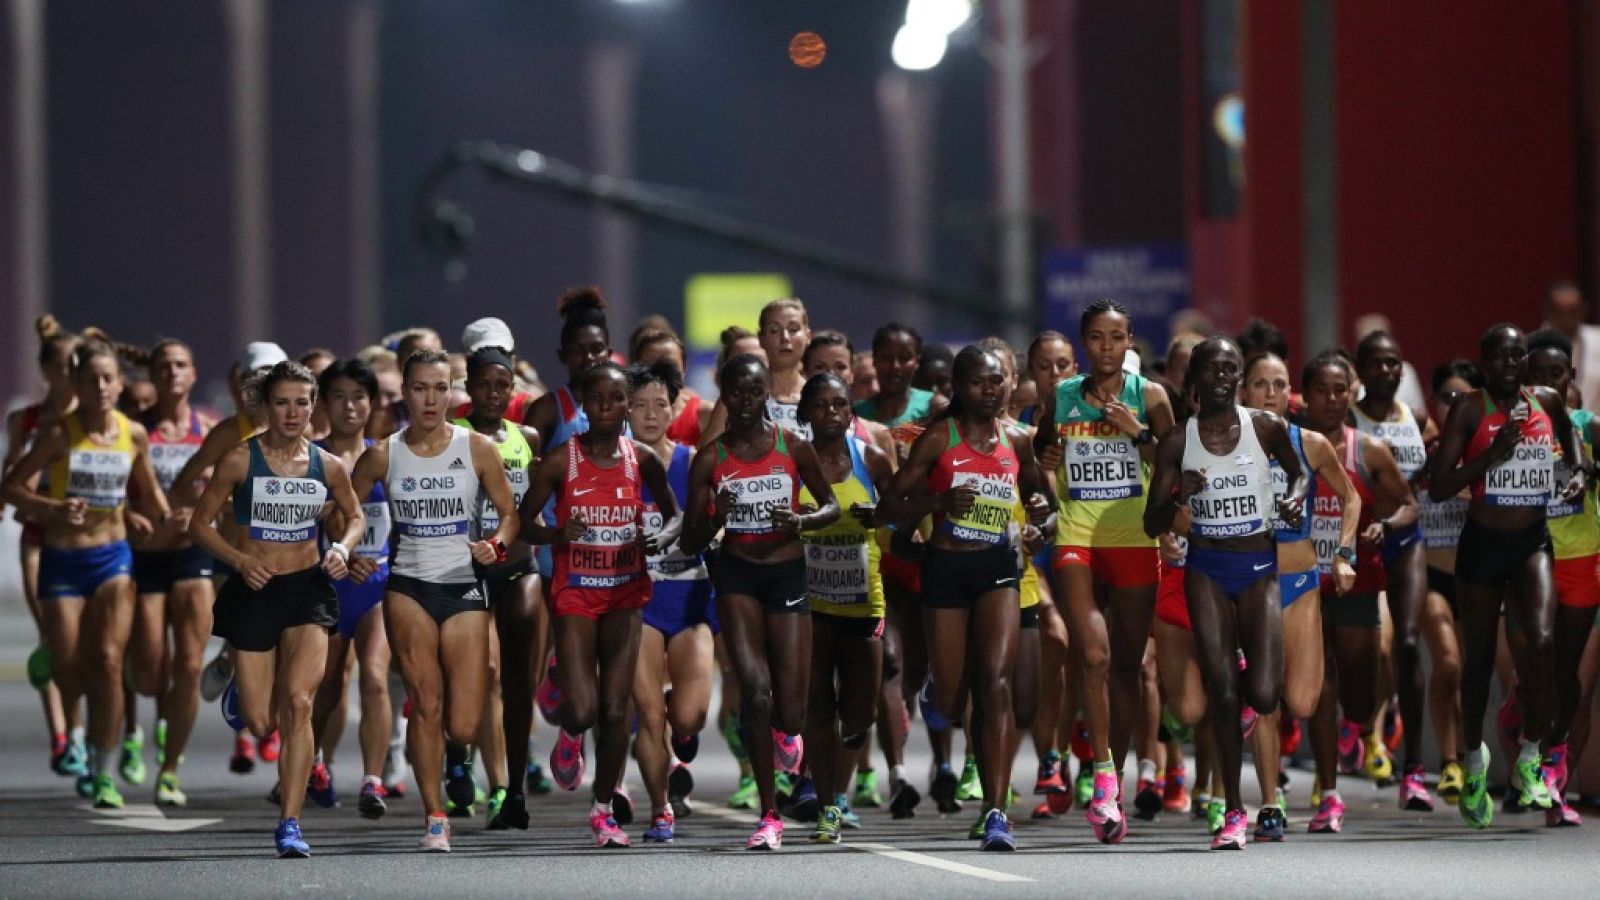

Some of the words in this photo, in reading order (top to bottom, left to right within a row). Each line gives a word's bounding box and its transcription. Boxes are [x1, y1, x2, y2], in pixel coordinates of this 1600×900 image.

[1093, 441, 1128, 454] QNB
[1517, 448, 1546, 460] QNB
[507, 472, 522, 483] NB
[1070, 461, 1137, 481] DEREJE
[420, 476, 455, 490] QNB
[747, 477, 781, 492] QNB
[1213, 474, 1247, 489] QNB
[1488, 469, 1551, 490] KIPLAGAT
[284, 481, 316, 494] QNB
[982, 482, 1011, 498] QNB
[1080, 487, 1131, 499] DOHA2019
[395, 497, 464, 519] TROFIMOVA
[1189, 495, 1257, 519] SALPETER
[262, 529, 308, 541] DOHA2019
[407, 524, 457, 536] DOHA2019
[601, 528, 632, 542] QNB
[953, 526, 1000, 543] DOHA2019
[1201, 523, 1252, 536] DOHA2019
[573, 548, 636, 569] CHELIMO
[826, 549, 858, 561] QNB
